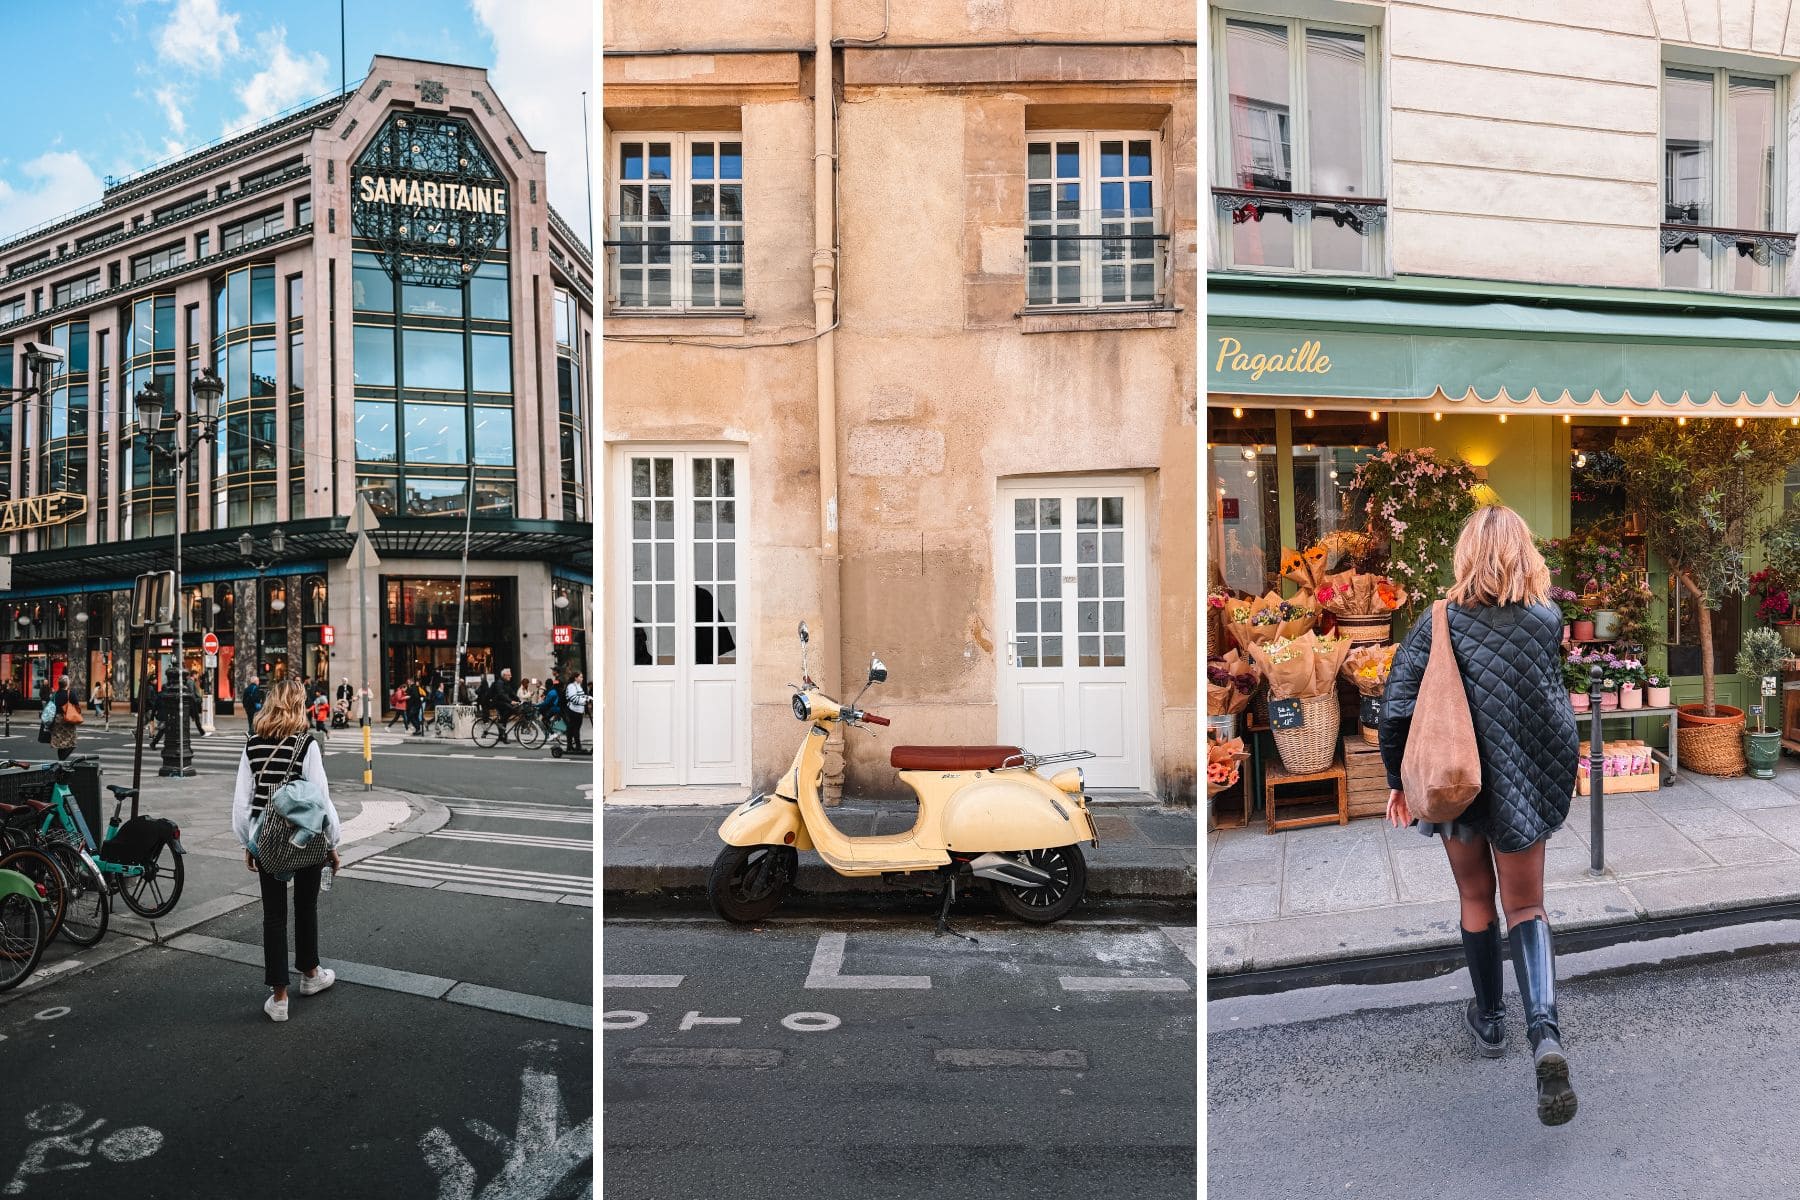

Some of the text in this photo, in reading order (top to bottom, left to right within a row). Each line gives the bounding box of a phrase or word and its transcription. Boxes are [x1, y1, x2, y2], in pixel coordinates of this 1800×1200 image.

[360, 175, 506, 215] SAMARITAINE
[1215, 337, 1332, 381] Pagaille
[0, 496, 61, 529] AINE
[554, 627, 569, 636] UNI
[554, 635, 570, 644] QLO
